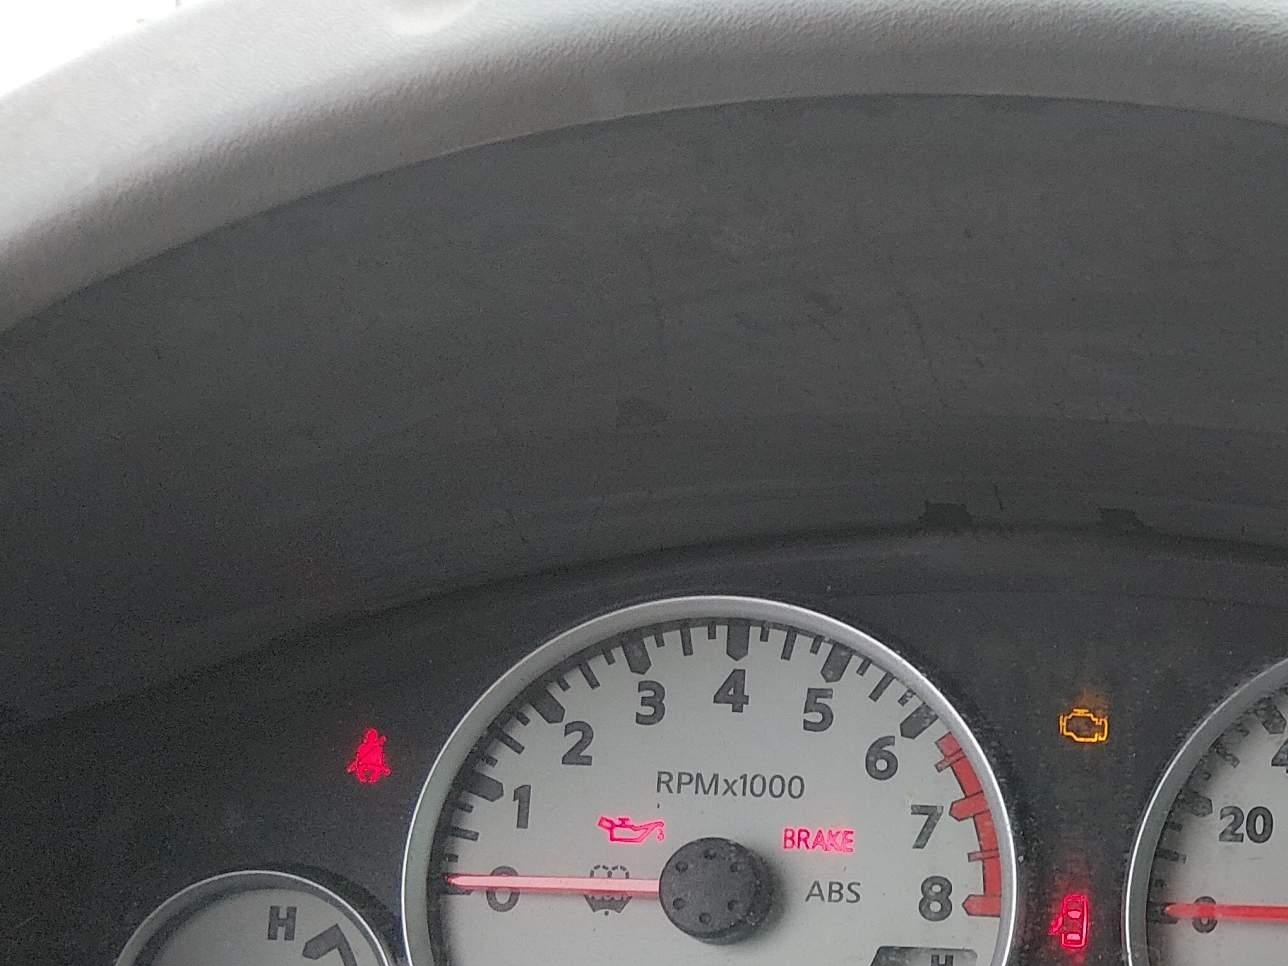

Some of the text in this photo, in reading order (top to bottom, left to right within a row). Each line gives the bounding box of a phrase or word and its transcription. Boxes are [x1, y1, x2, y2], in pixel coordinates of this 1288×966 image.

[636, 680, 665, 724] 3
[714, 669, 749, 712] 4
[803, 688, 833, 732] 5
[562, 721, 593, 765] 2
[866, 736, 898, 780] 6
[513, 784, 531, 828] 1
[656, 771, 805, 799] RPMx1000
[783, 827, 855, 853] BRAKE
[911, 805, 943, 849] 7
[1219, 807, 1274, 843] 20
[486, 866, 520, 912] 0
[806, 881, 861, 904] ABS
[919, 876, 952, 921] 8
[267, 906, 297, 940] H
[1192, 896, 1217, 933] 0
